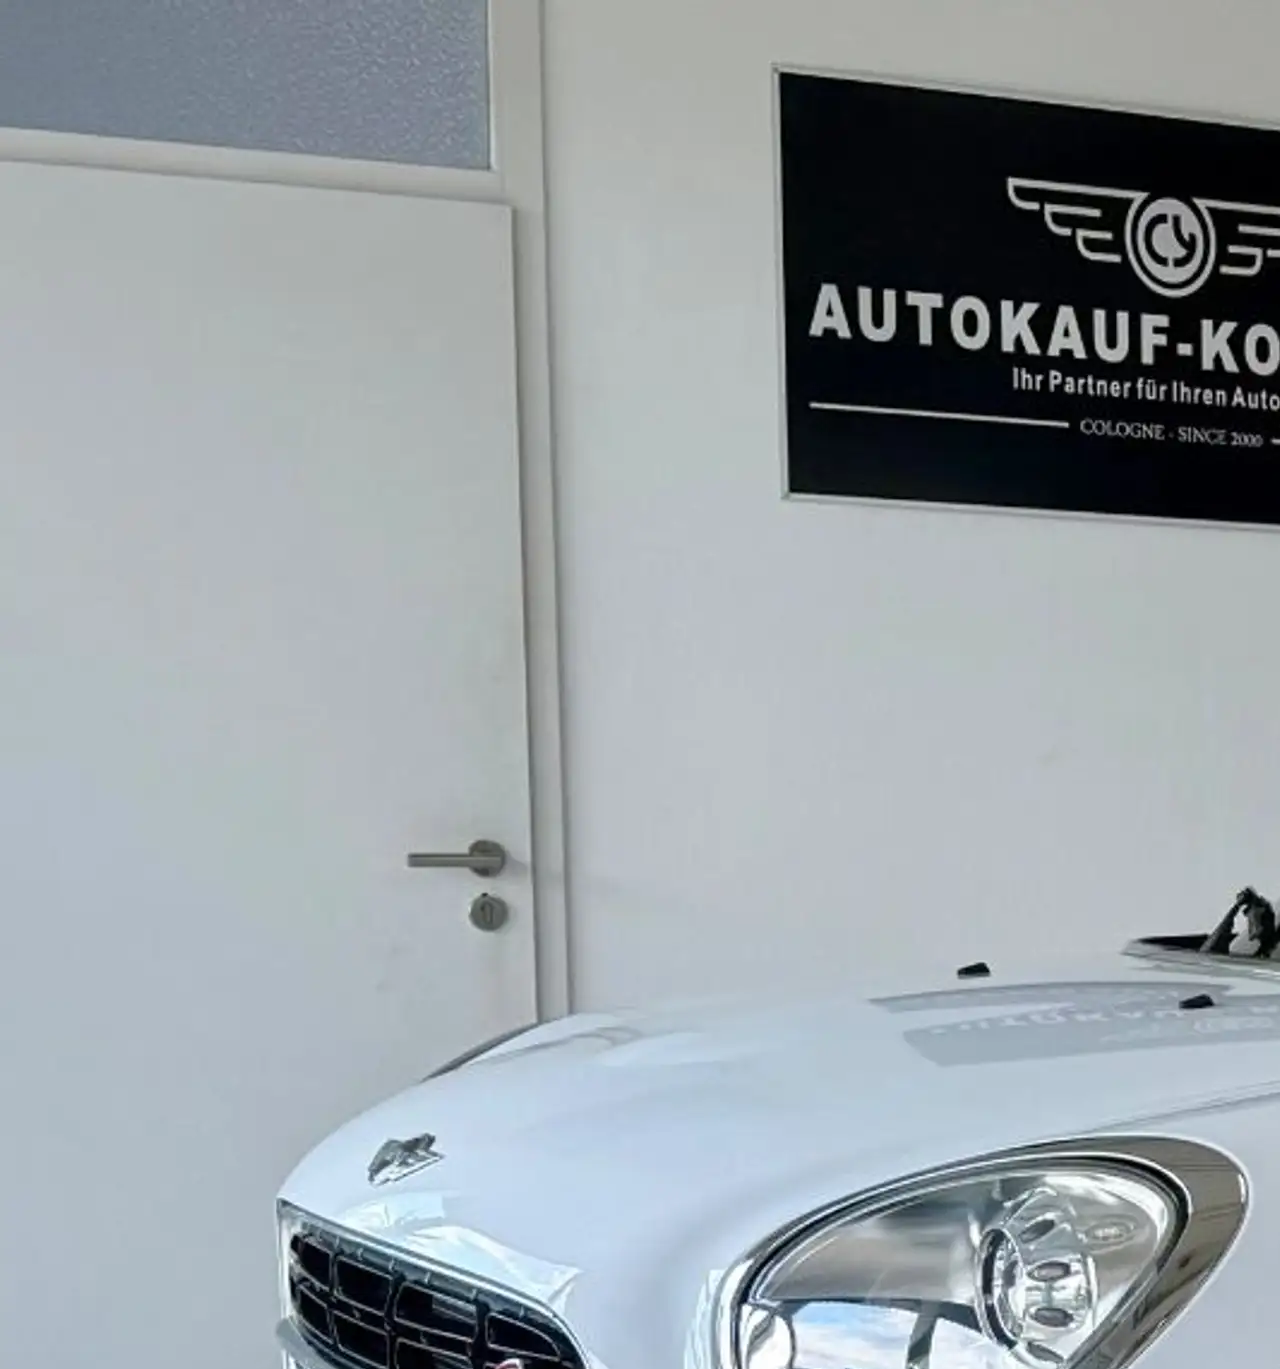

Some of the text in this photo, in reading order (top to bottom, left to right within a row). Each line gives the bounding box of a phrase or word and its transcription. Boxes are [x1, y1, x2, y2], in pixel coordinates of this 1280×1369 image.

[1012, 366, 1044, 391] Ihr
[1049, 369, 1131, 399] Partner
[1136, 376, 1169, 402] für
[1172, 380, 1227, 408] Ihren
[1079, 417, 1166, 441] COLOGNE
[1177, 425, 1228, 446] SINCE
[1230, 430, 1265, 447] 2000
